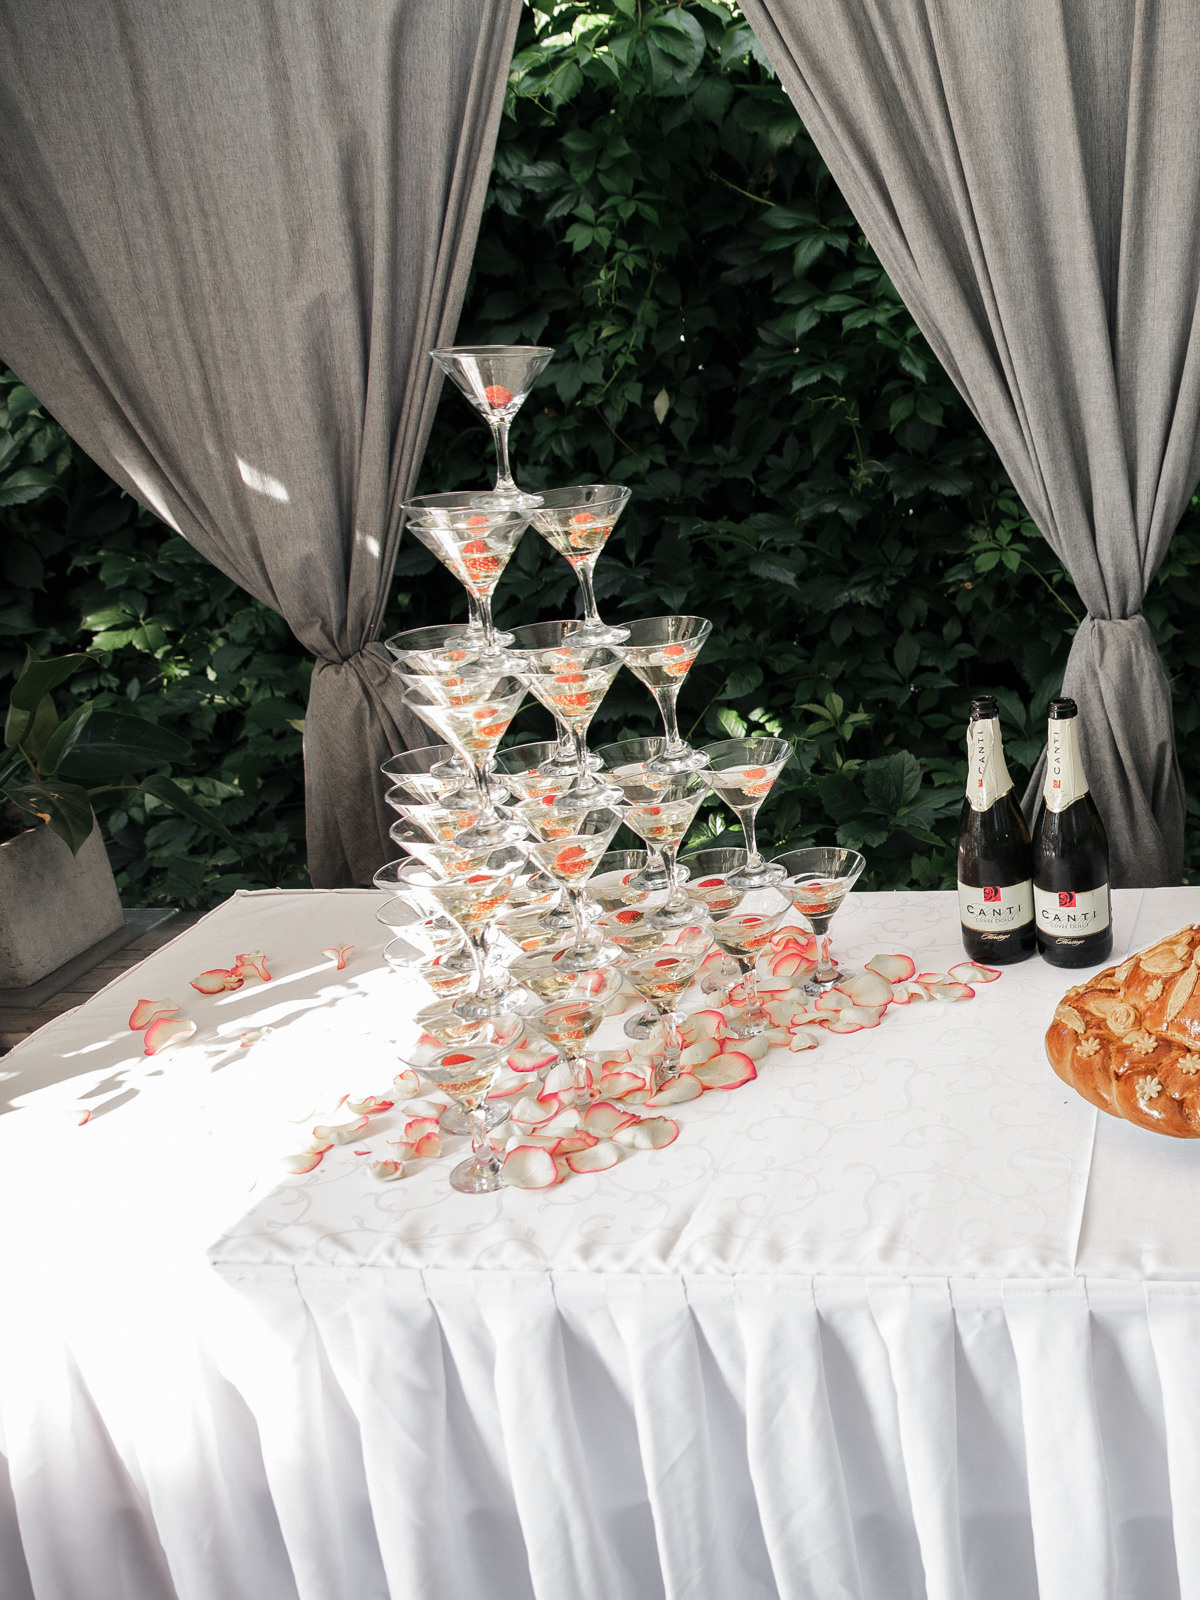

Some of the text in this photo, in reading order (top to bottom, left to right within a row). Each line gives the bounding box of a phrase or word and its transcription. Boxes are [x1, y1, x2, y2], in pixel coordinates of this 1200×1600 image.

[1053, 731, 1061, 775] CANTI
[966, 904, 1022, 916] CANTI
[1041, 909, 1097, 922] CANTI
